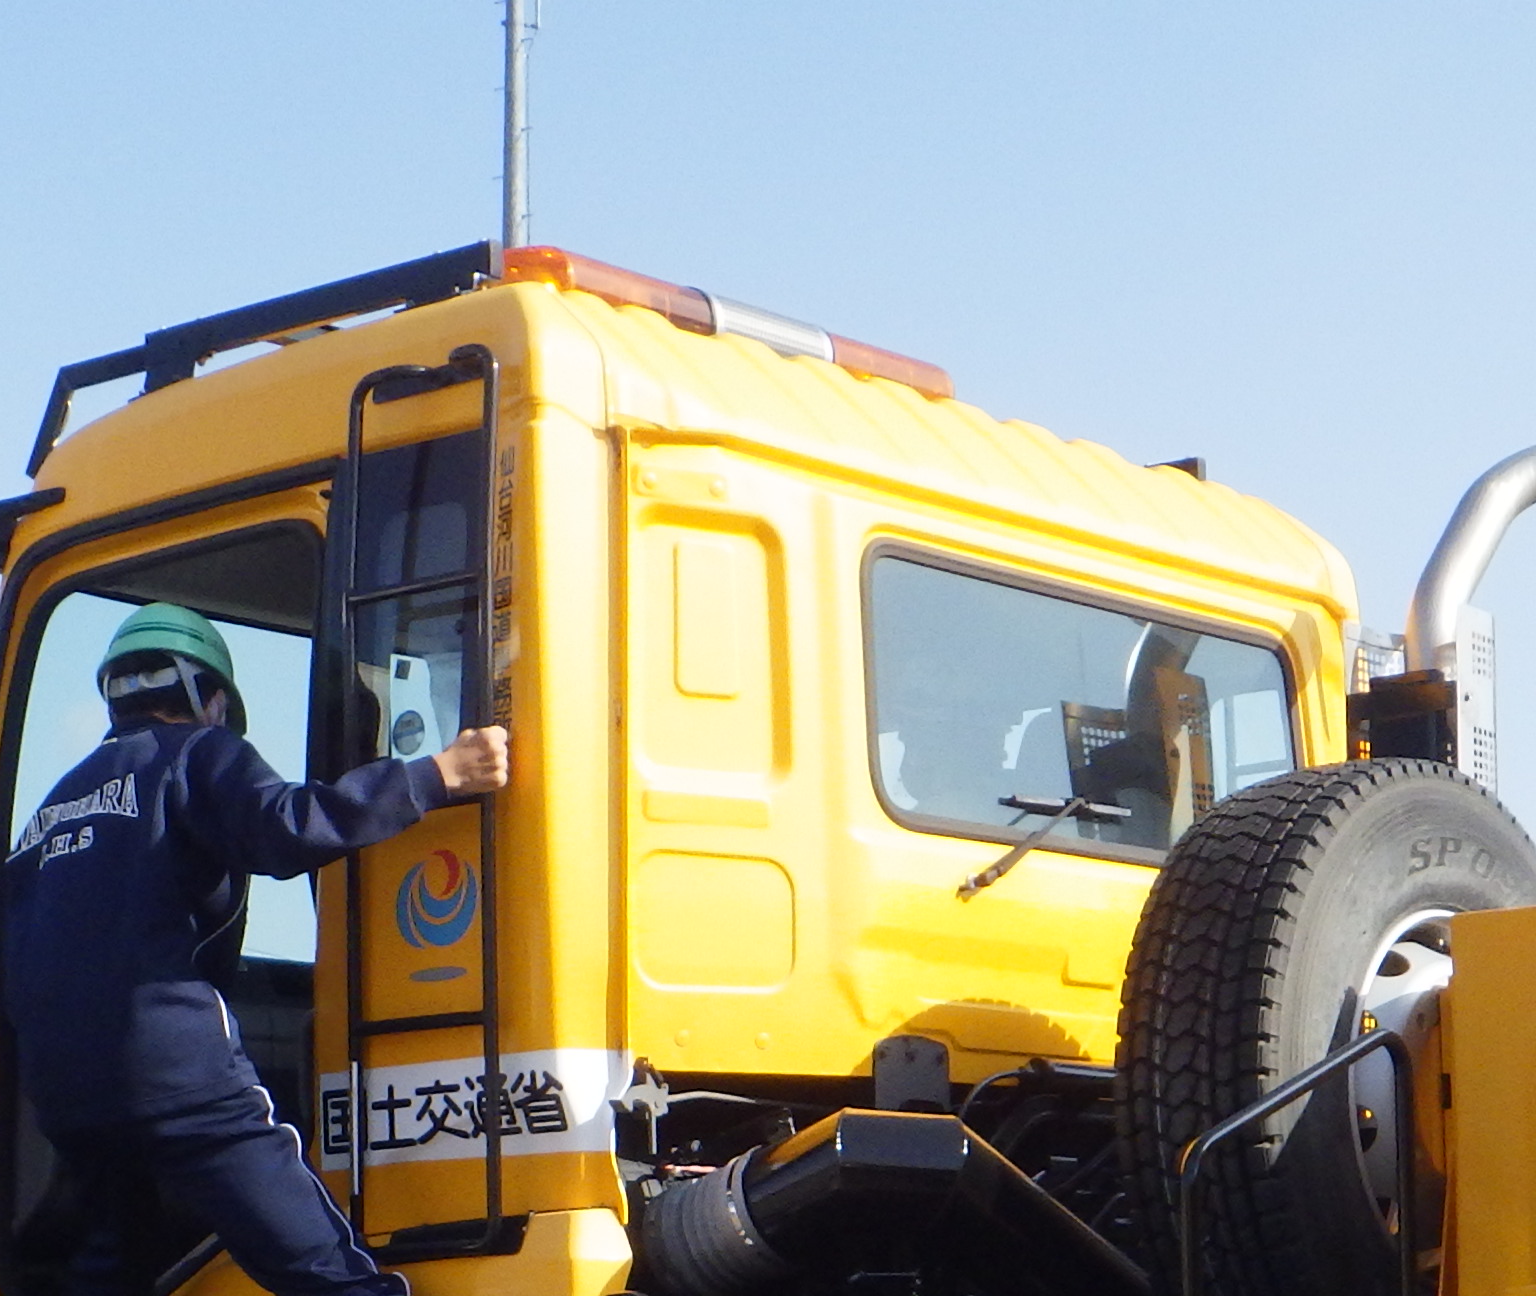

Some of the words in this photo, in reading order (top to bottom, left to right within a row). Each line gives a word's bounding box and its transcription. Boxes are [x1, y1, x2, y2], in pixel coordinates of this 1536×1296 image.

[322, 1069, 569, 1155] 国土交通省
